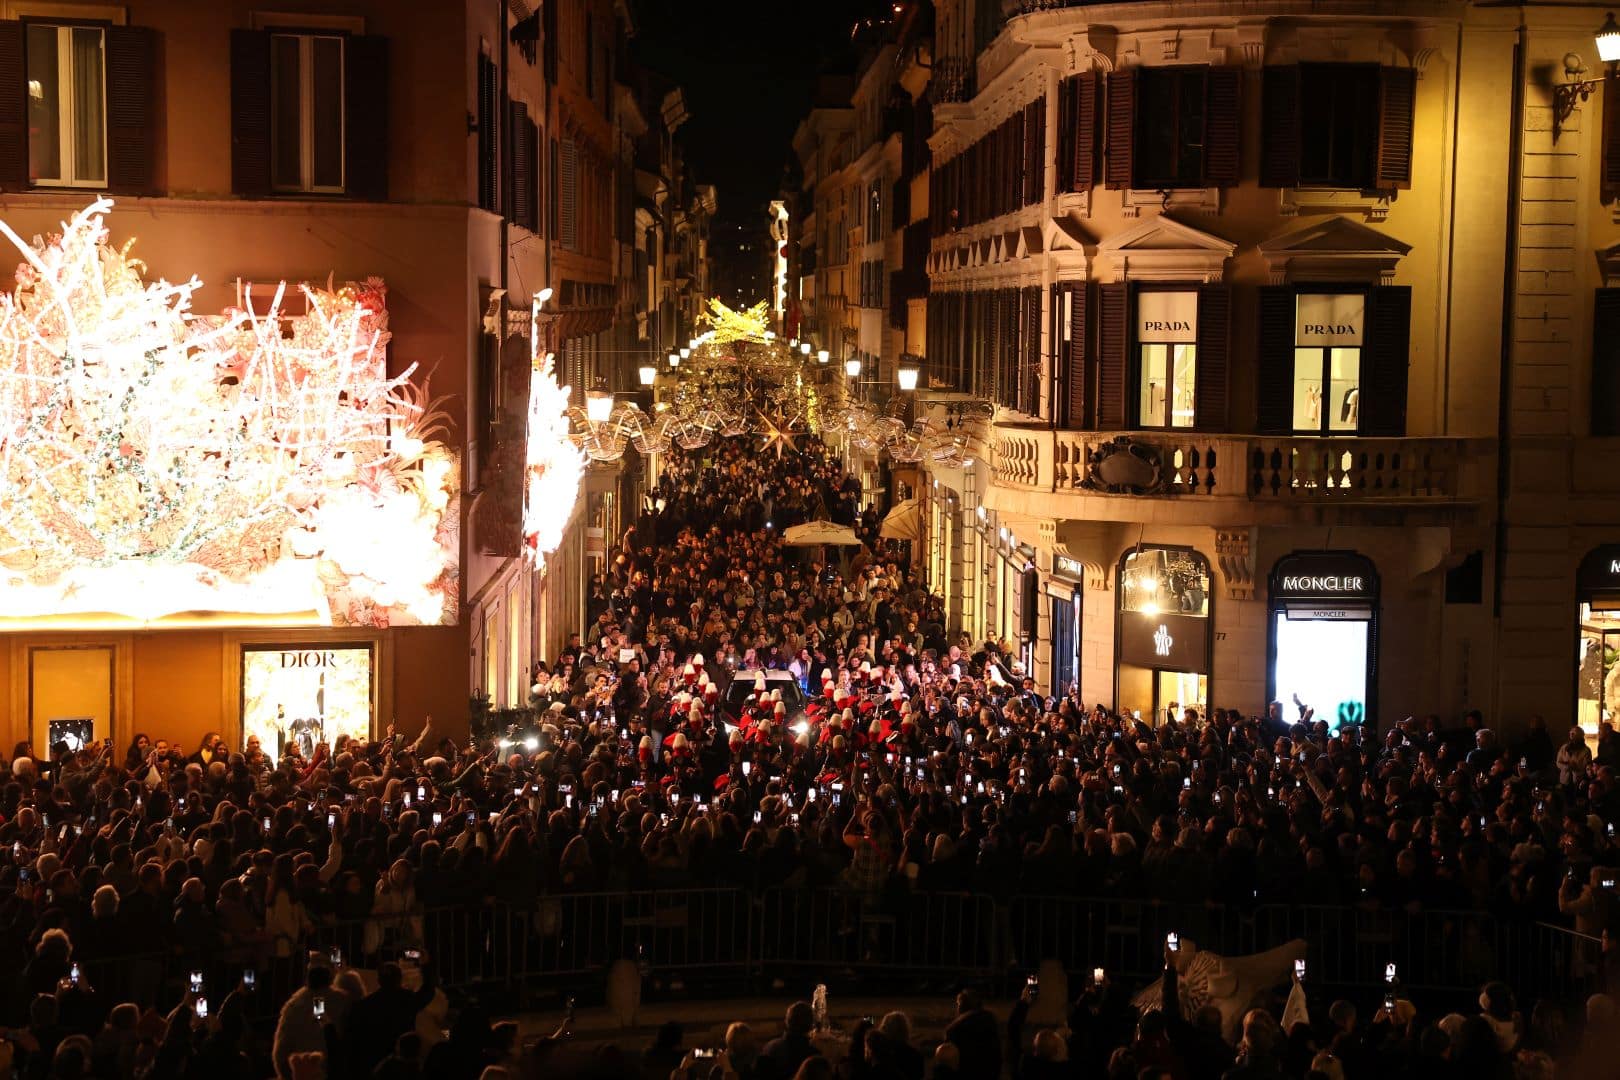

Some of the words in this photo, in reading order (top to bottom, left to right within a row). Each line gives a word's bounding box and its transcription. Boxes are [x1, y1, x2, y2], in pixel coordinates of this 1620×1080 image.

[1145, 321, 1190, 331] PRADA
[1304, 324, 1355, 335] PRADA
[1283, 576, 1363, 591] MONCLER
[280, 652, 336, 668] DIOR
